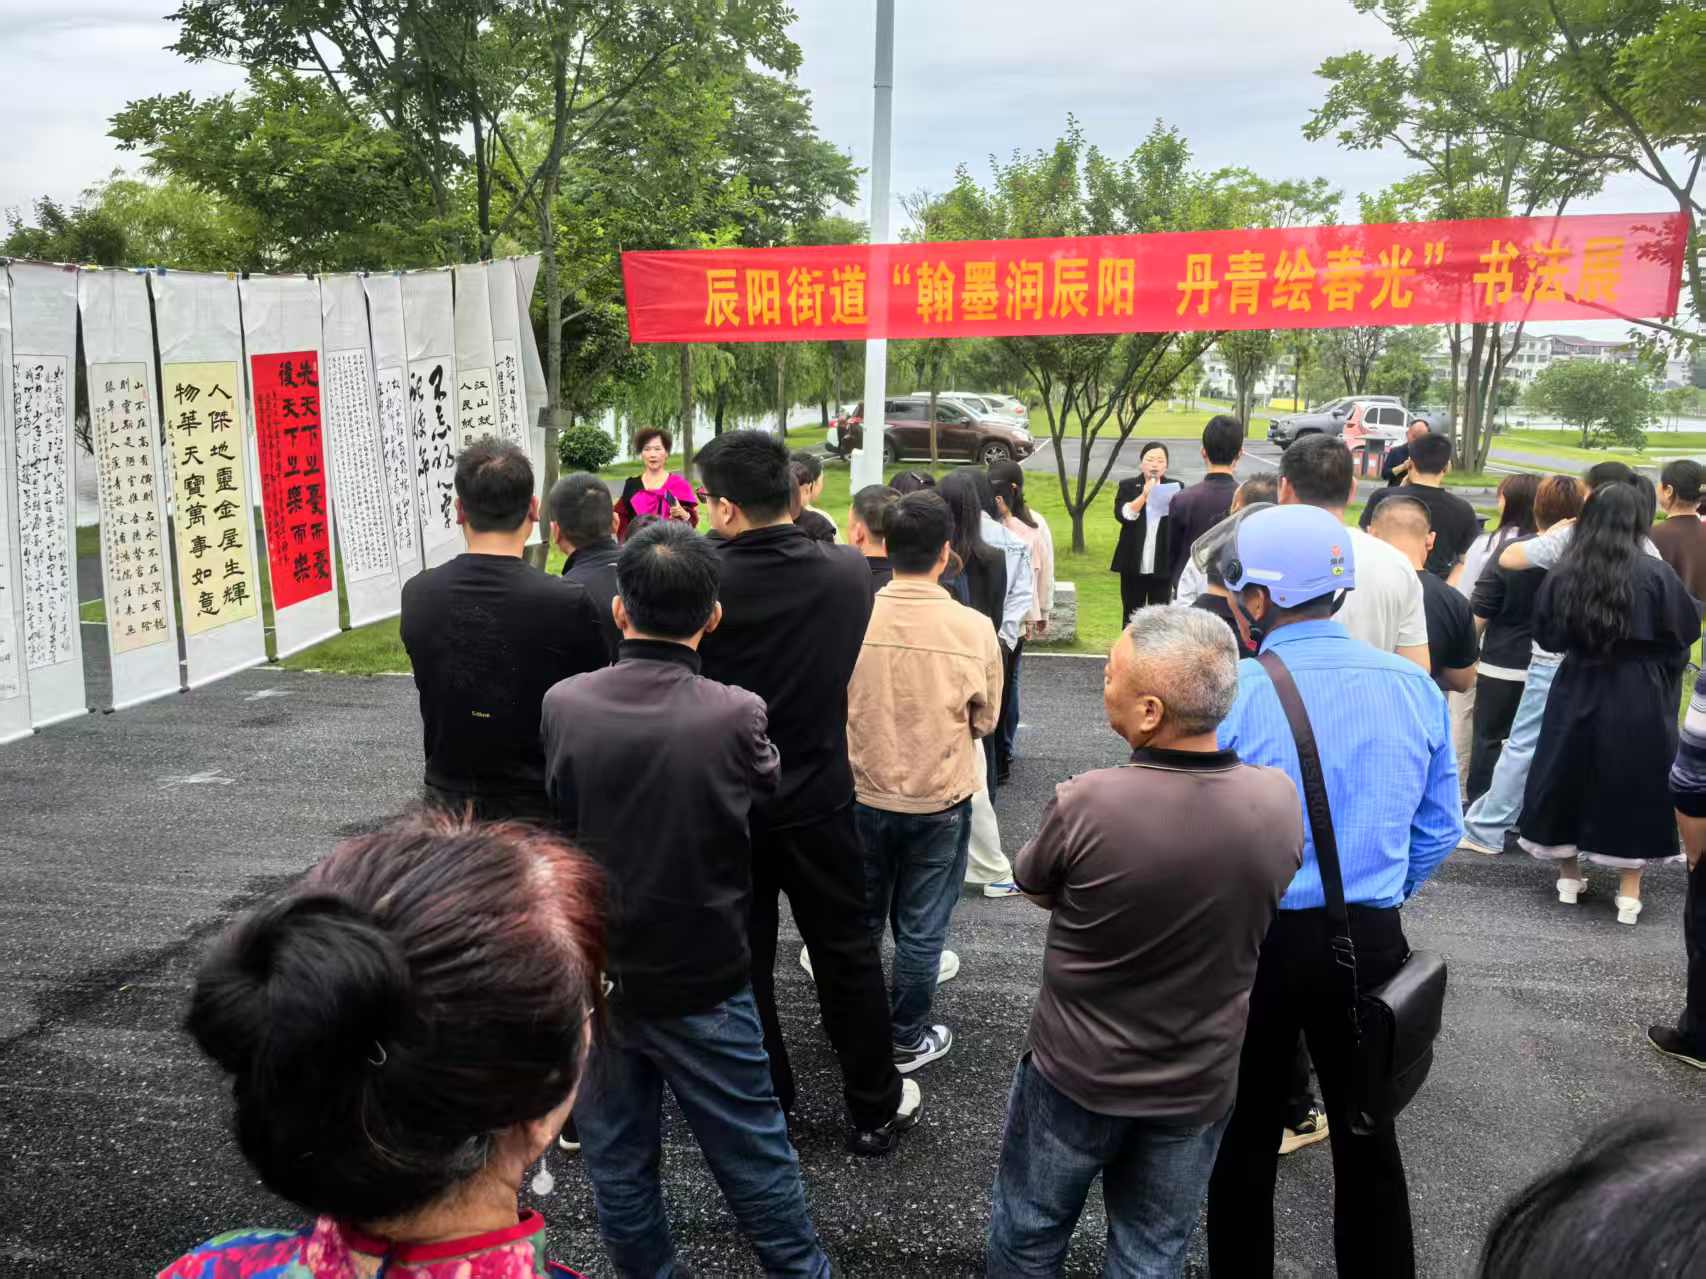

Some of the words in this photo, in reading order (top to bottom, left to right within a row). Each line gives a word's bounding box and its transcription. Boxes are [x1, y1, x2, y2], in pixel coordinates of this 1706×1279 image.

[704, 265, 868, 328] 辰阳街道
[893, 257, 1136, 322] “翰墨润辰阳
[1176, 241, 1445, 316] 丹青绘春光”
[1473, 236, 1626, 305] 书法展
[174, 383, 220, 617] 物華天寶萬事如意
[207, 383, 251, 607] 人傑地靈金屋生輝
